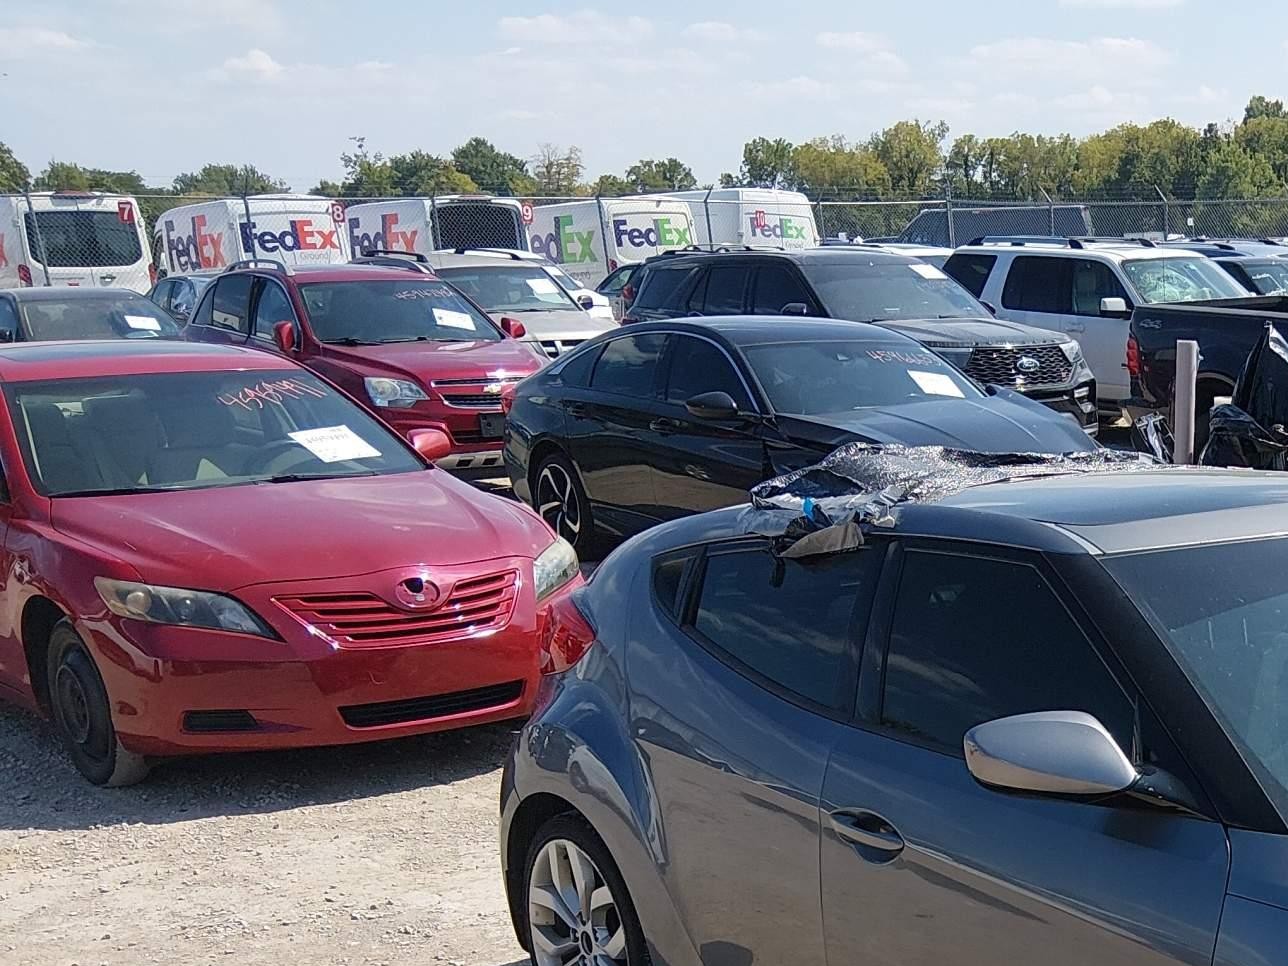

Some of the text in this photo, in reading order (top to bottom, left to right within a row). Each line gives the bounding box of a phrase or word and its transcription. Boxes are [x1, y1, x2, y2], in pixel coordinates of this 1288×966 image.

[121, 203, 131, 221] 7
[332, 205, 344, 222] 8
[521, 205, 533, 221] 9
[756, 211, 766, 228] 10
[164, 214, 227, 273] FedEx
[239, 219, 342, 253] FedEx
[530, 215, 598, 264] edEx
[612, 218, 690, 248] FedEx
